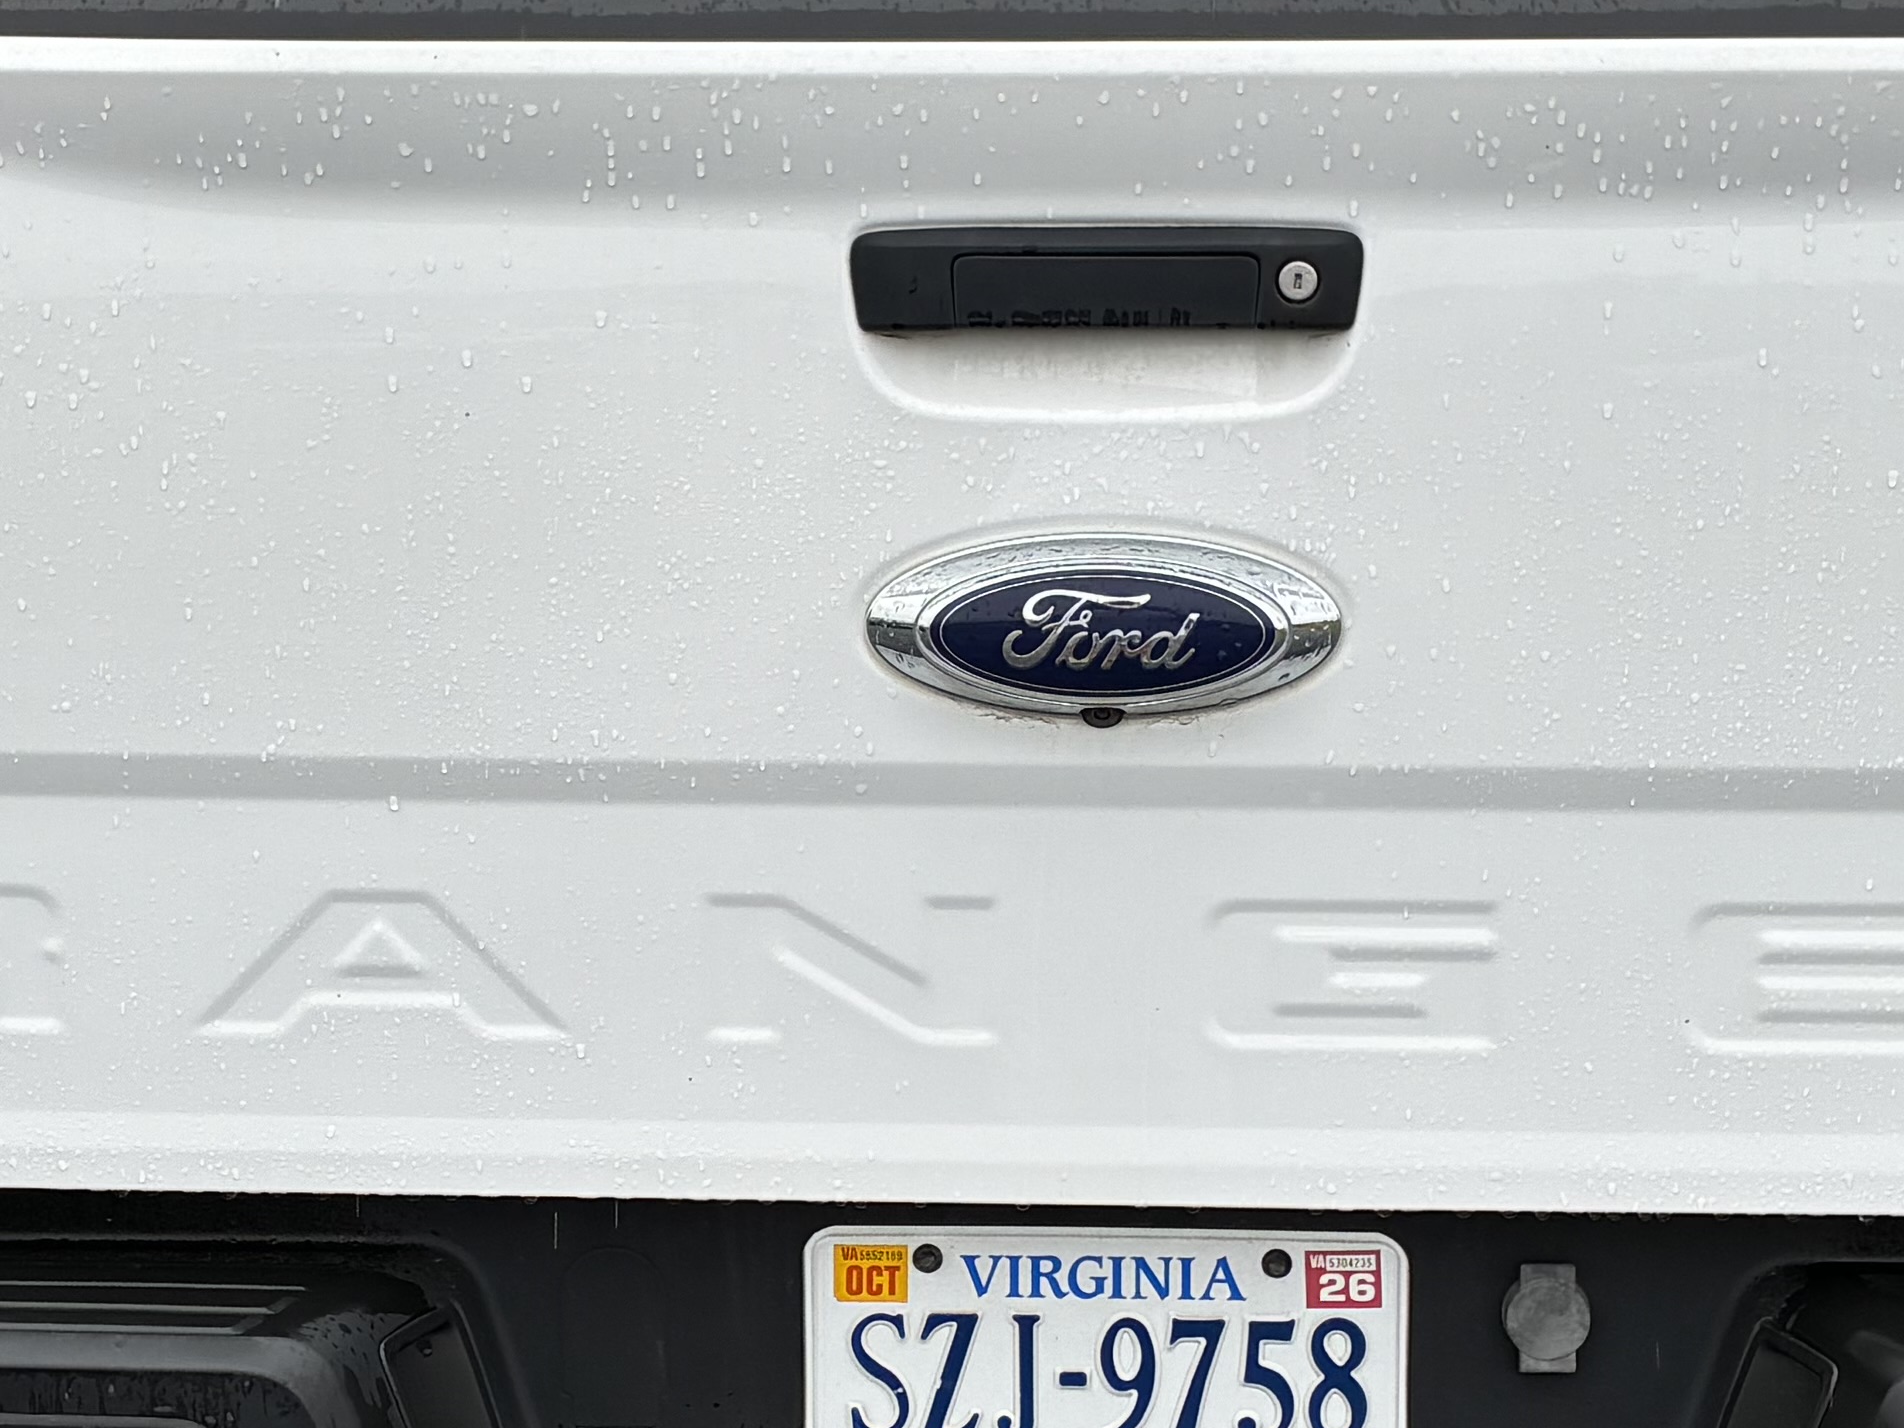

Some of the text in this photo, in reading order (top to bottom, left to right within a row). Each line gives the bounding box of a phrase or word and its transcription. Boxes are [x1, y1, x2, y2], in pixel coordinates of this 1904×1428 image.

[1002, 588, 1201, 670] Ford
[841, 1246, 859, 1261] VA
[1309, 1254, 1325, 1269] VA
[846, 1264, 901, 1297] OCT
[959, 1254, 1248, 1302] VIRGINIA
[1318, 1272, 1377, 1303] 26
